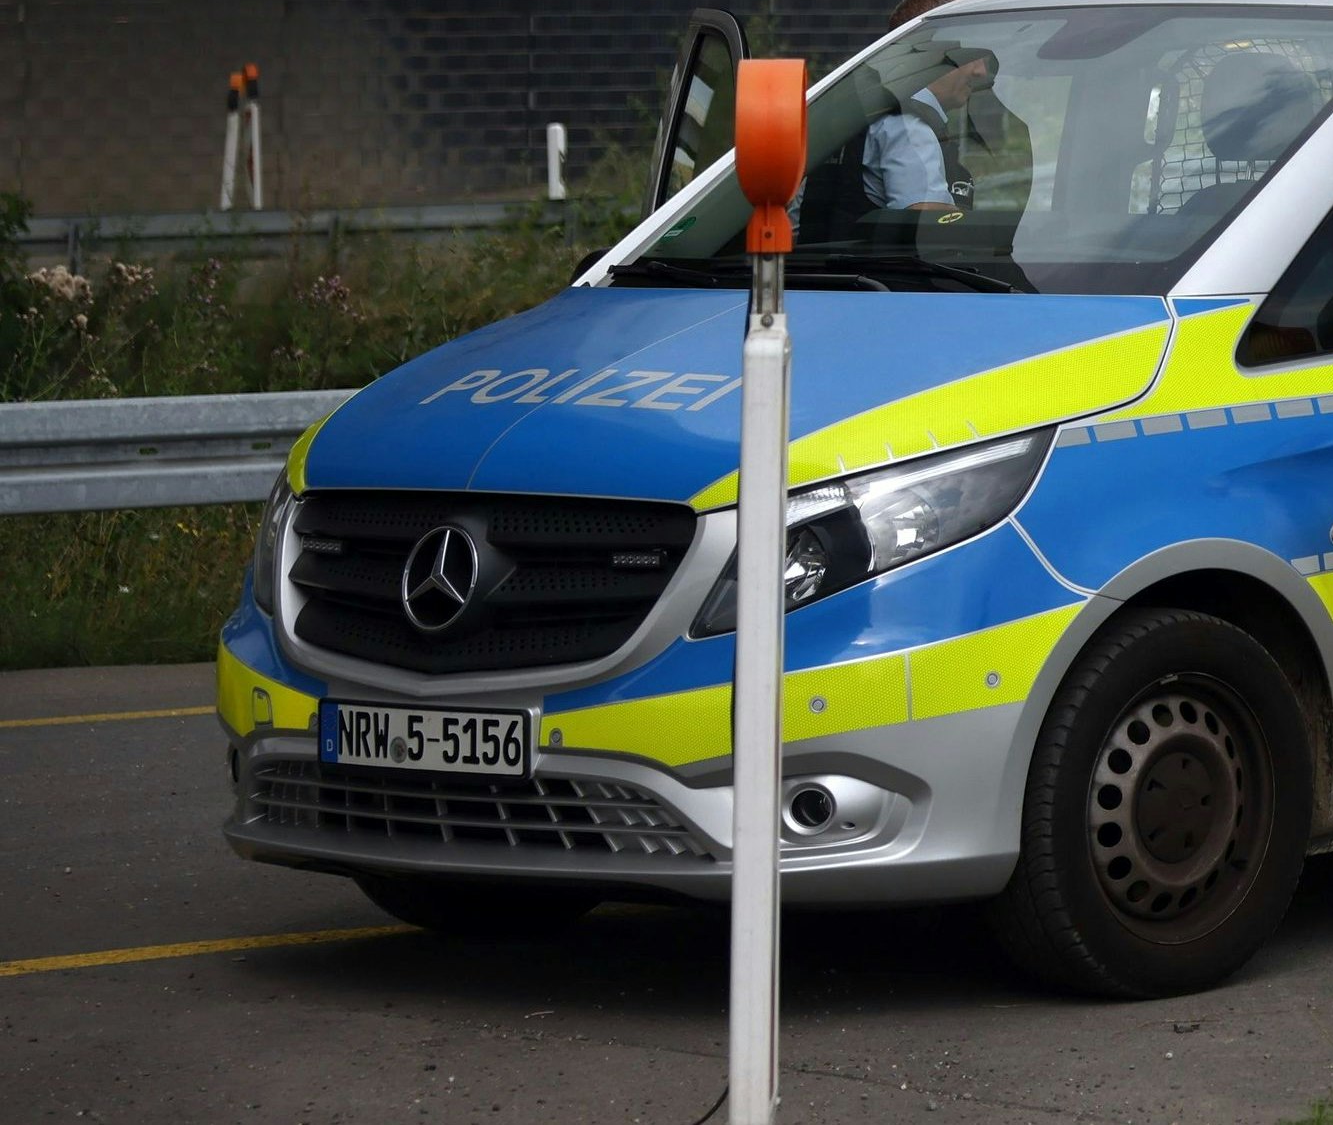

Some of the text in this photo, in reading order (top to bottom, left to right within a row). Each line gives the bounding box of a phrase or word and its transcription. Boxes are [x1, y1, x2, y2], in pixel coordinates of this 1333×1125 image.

[418, 368, 743, 412] POLIZEI
[326, 738, 334, 752] D
[338, 710, 521, 767] NRW 5-5156
